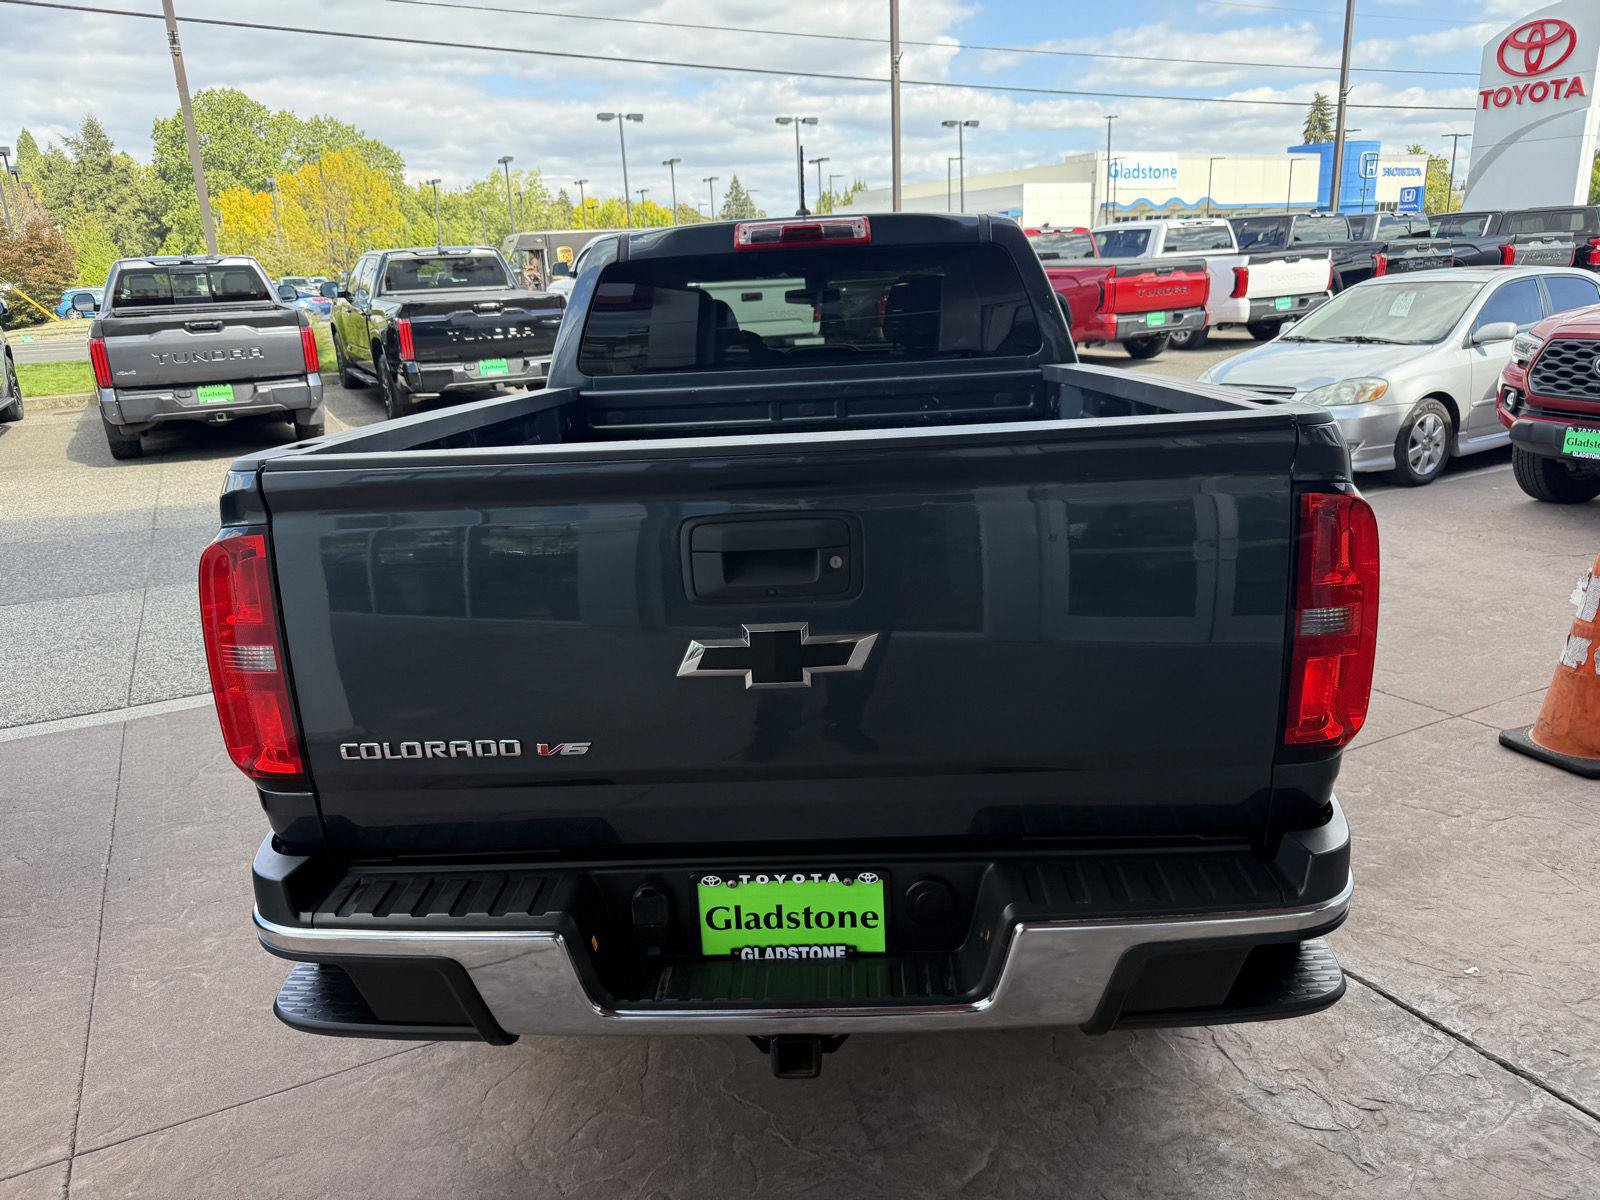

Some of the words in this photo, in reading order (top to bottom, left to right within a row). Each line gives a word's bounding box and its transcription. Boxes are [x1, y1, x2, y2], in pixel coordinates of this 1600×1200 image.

[1479, 76, 1586, 110] TOYOTA
[1108, 161, 1178, 179] Gladstone
[1382, 167, 1422, 177] HONDA
[447, 326, 535, 342] TUNDRA
[151, 345, 265, 365] TUNDRA
[339, 739, 522, 760] COLORADO
[536, 742, 592, 756] V6
[739, 873, 840, 885] TOYOTA
[705, 904, 880, 931] Gladstone
[741, 945, 847, 960] GLADSTONE
